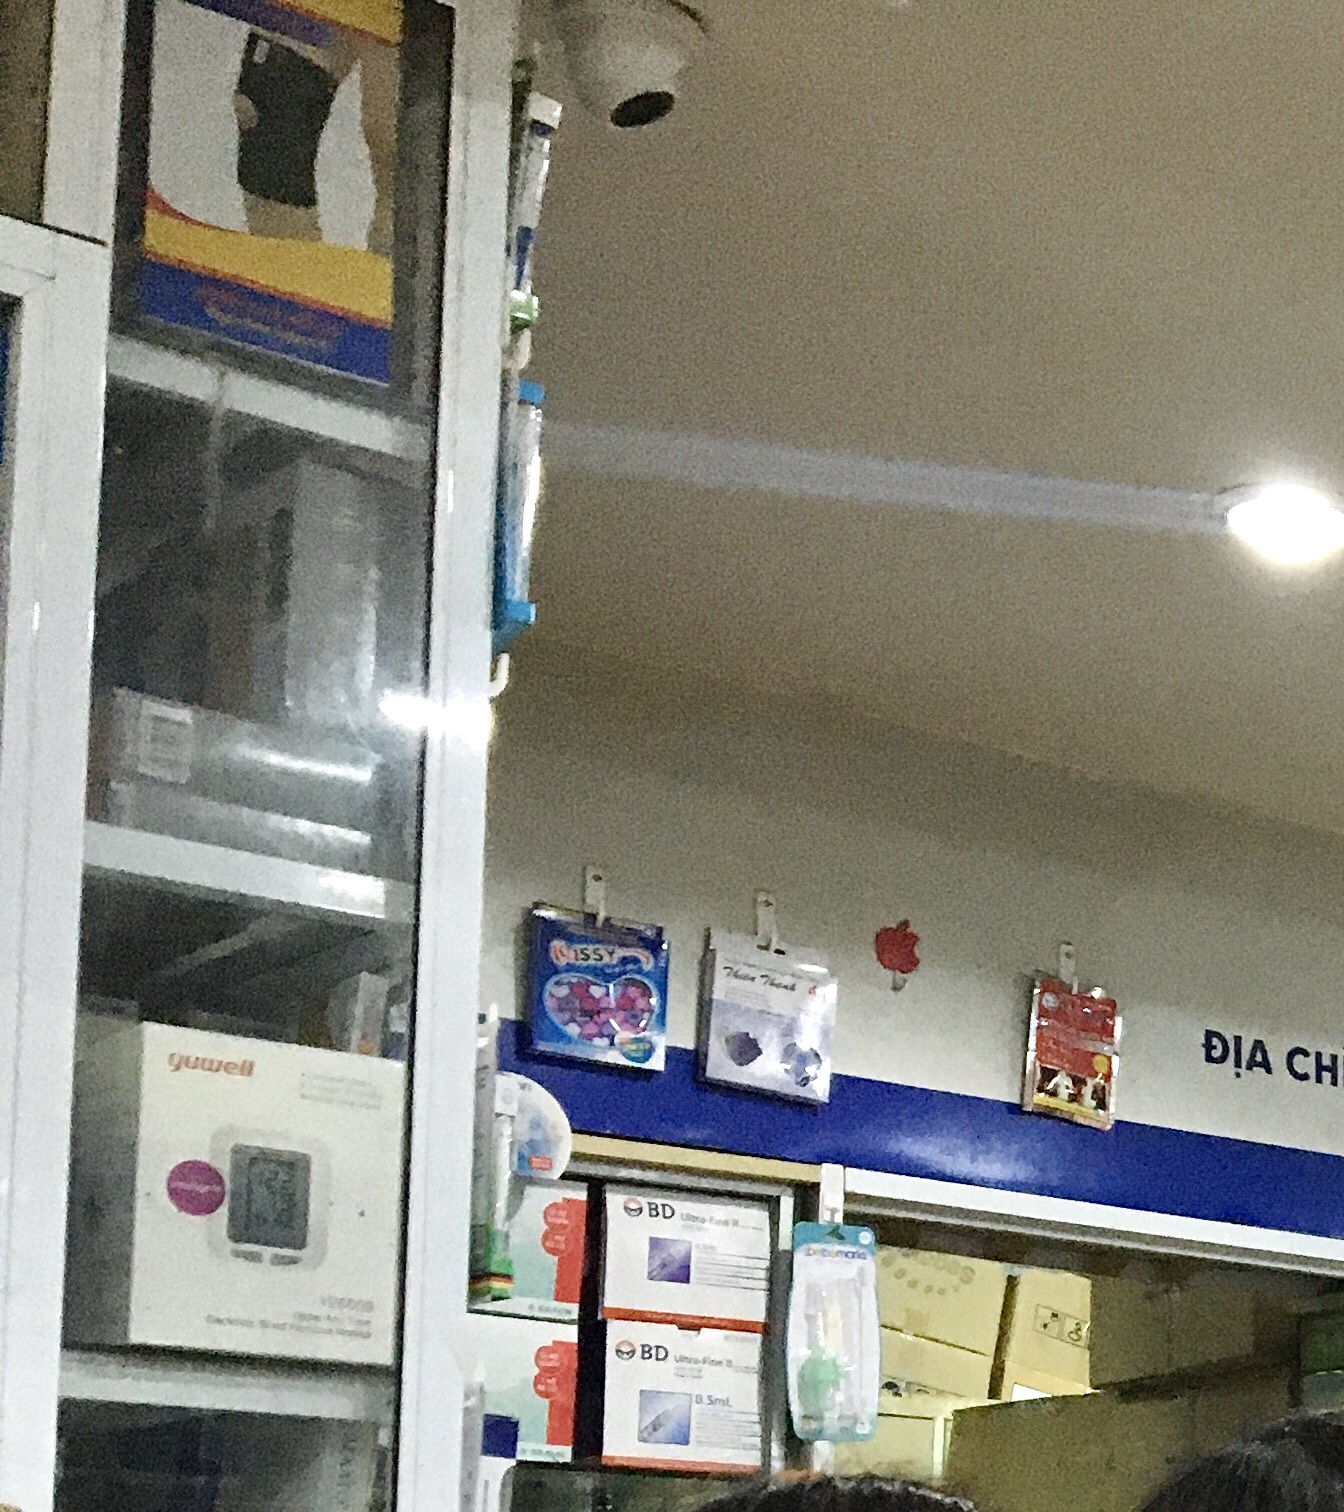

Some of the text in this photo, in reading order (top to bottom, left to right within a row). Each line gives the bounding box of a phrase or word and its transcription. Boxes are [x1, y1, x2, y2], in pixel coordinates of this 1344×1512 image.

[1202, 1027, 1273, 1079] ĐỊA
[646, 1201, 676, 1220] BD
[639, 1343, 670, 1362] BD
